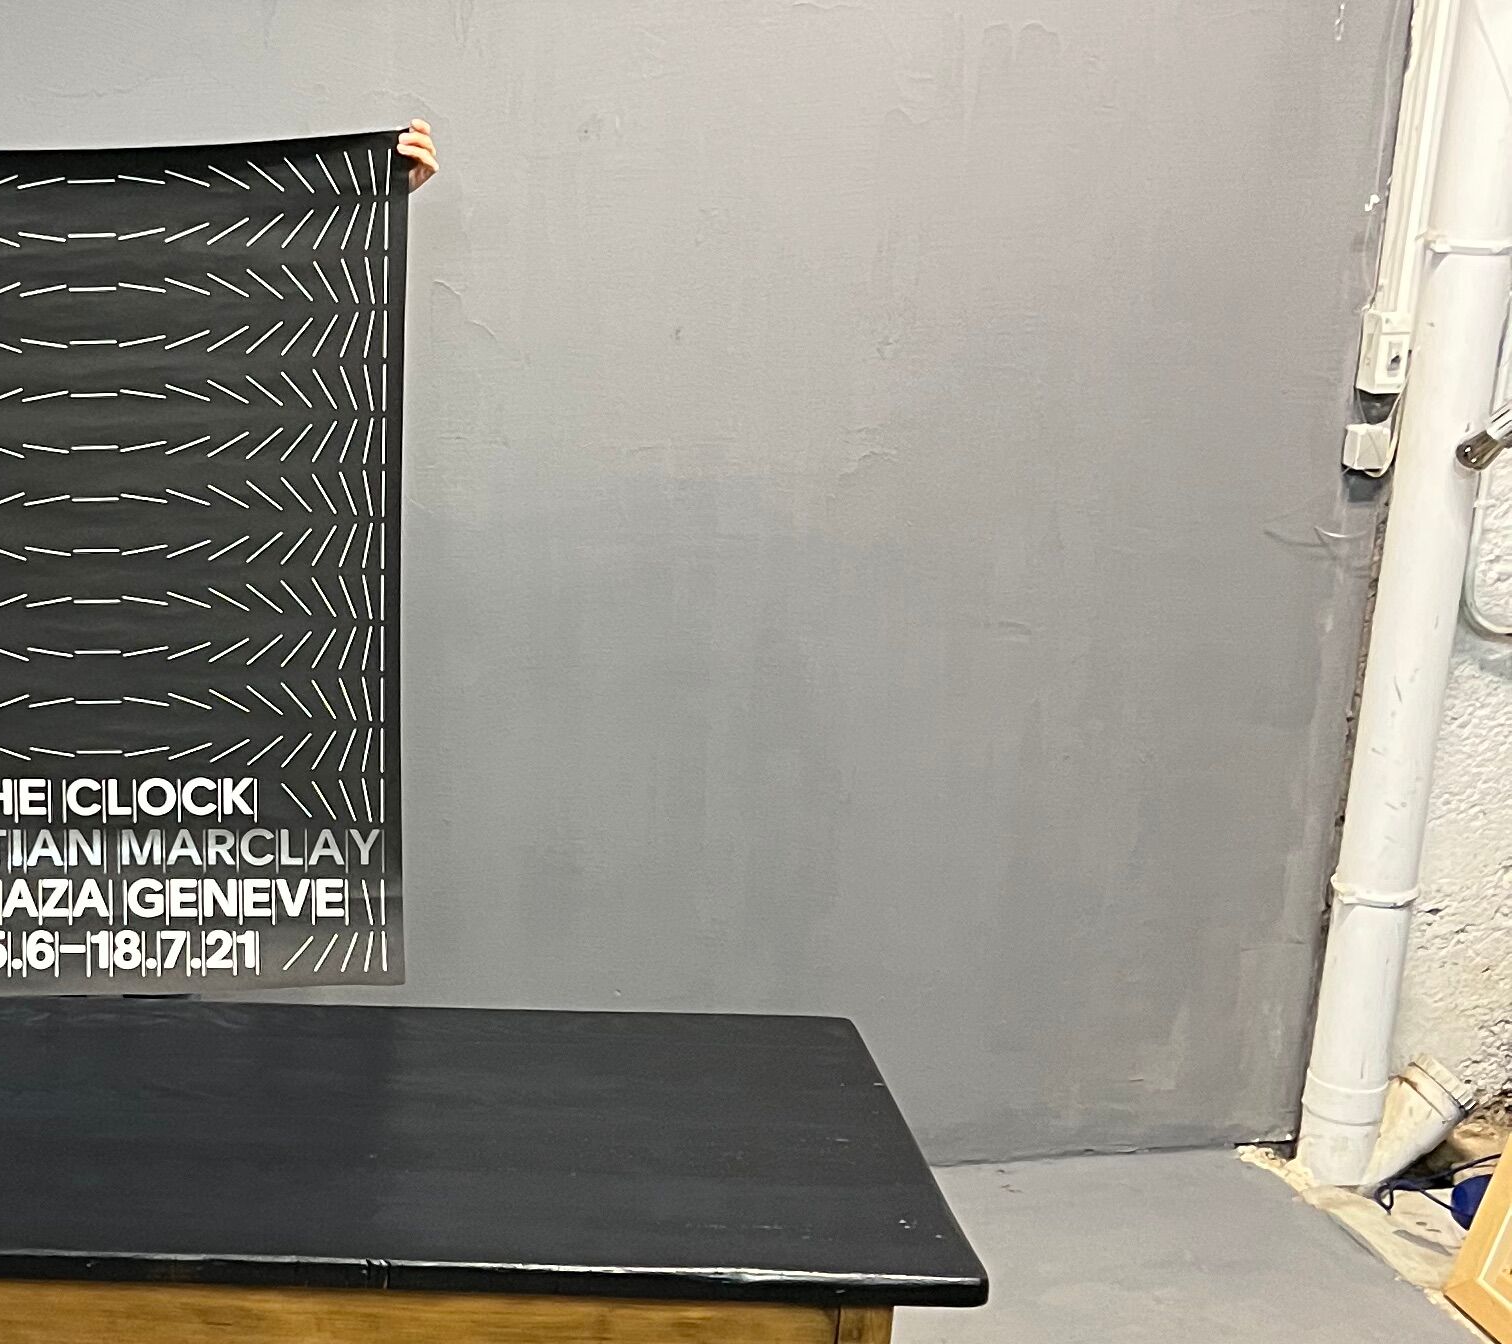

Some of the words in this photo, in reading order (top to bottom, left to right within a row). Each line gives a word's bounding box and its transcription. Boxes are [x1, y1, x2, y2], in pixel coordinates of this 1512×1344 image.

[66, 777, 255, 817] CLOCK
[121, 828, 380, 866] MARCLAY
[127, 878, 345, 919] GENEVE
